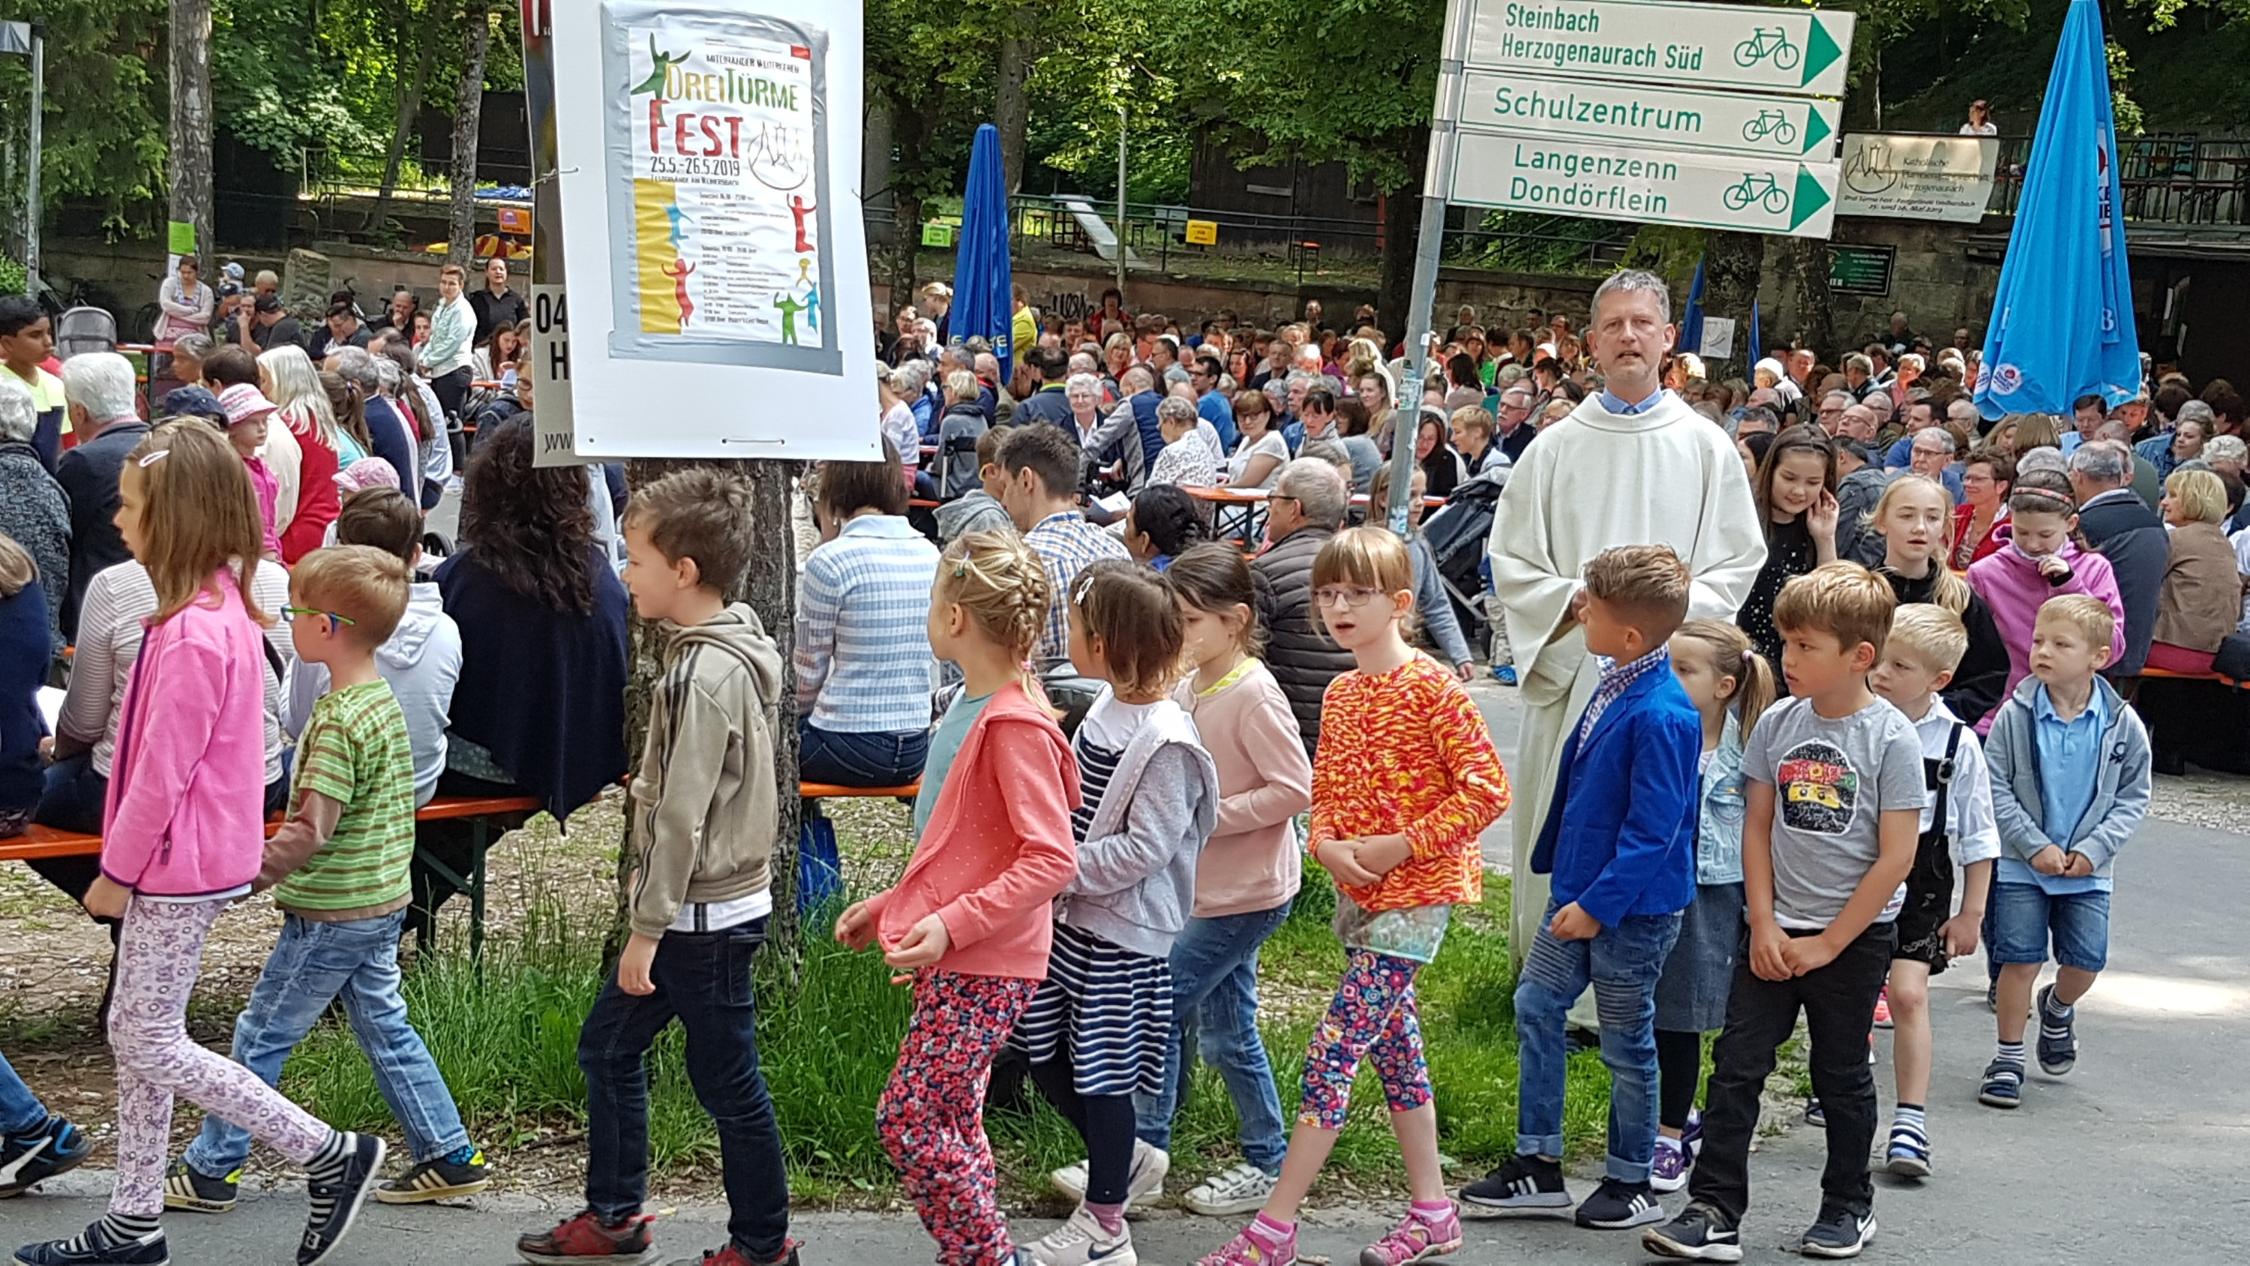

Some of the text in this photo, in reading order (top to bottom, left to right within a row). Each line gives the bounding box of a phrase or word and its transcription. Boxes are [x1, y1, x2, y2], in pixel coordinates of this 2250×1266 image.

[1505, 3, 1600, 33] Steinbach
[1501, 33, 1703, 70] Herzogenaurach Süd
[1494, 87, 1702, 132] Schulzentrum
[649, 99, 744, 159] FEST
[650, 156, 740, 177] 25.5.-26.5.2019
[1514, 143, 1677, 181] Langenzenn
[1510, 176, 1668, 213] Dondörflein
[1900, 181, 1965, 193] Herzogenaurach
